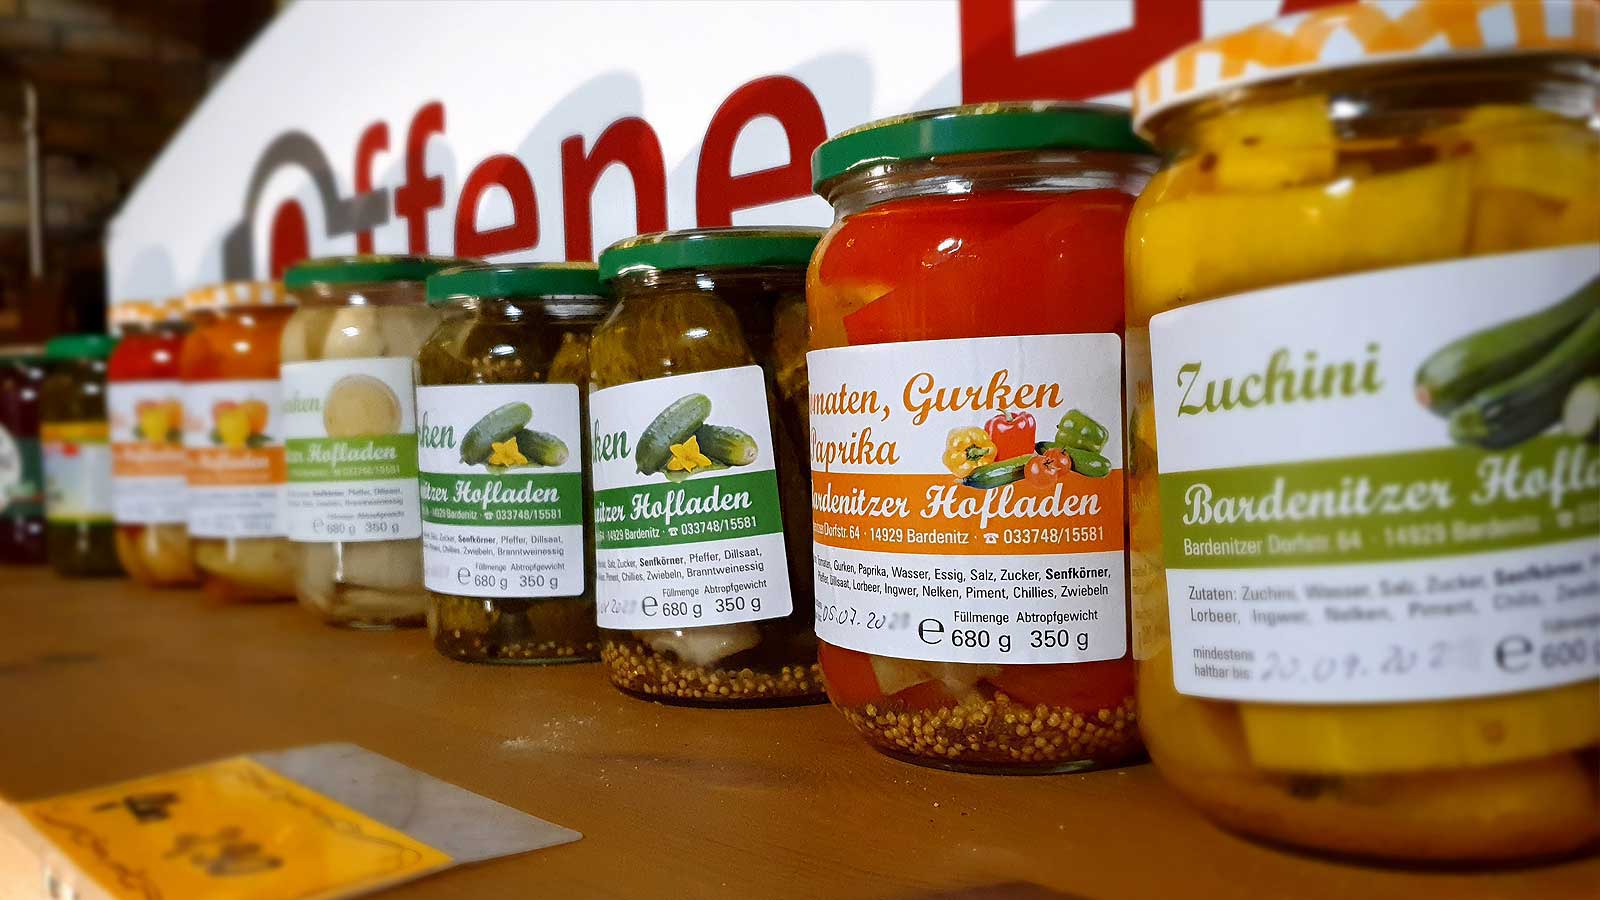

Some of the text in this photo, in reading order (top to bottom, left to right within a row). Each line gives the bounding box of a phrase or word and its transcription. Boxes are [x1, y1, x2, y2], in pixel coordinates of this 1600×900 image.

[1177, 343, 1384, 417] Zuchini
[810, 369, 1063, 426] maten, Gurken
[418, 411, 456, 449] ken
[592, 418, 631, 464] ken
[453, 480, 560, 510] Hofladen
[630, 485, 752, 525] Hofladen
[1183, 476, 1454, 526] Bardenitzer
[496, 509, 561, 519] 033748/15581
[811, 482, 910, 518] ardenitzer
[920, 482, 1101, 530] Hofladen
[625, 526, 661, 540] Bardenitz
[681, 516, 757, 535] 033748/15581
[824, 522, 849, 538] Dorfstr.
[849, 526, 860, 539] 64
[871, 528, 903, 543] 14929
[907, 528, 969, 544] Bardenitz
[1003, 526, 1104, 544] 033748/15581
[498, 547, 564, 557] Branntweinessig
[1184, 536, 1263, 556] Bardenitzer
[511, 562, 565, 573] Abtropfgewicht
[640, 556, 687, 568] Senfkörner,
[689, 552, 721, 564] Pfeffer,
[724, 547, 762, 561] Dillsaat,
[646, 568, 685, 581] Zwiebeln,
[687, 561, 765, 578] Branntweinessig
[833, 559, 857, 575] Gurken,
[858, 562, 889, 579] Paprika,
[892, 566, 931, 581] Wasser,
[934, 568, 967, 583] Essig,
[970, 568, 998, 582] Salz,
[1000, 569, 1042, 582] Zucker,
[1045, 566, 1111, 581] Senfkörner,
[474, 574, 496, 588] 680
[500, 576, 508, 590] g
[519, 575, 545, 588] 350
[549, 577, 558, 590] g
[662, 579, 767, 599] Füllmenge Abtropfgewicht
[853, 581, 882, 595] Lorbeer,
[884, 582, 919, 598] Ingwer,
[922, 585, 962, 600] Nelken,
[966, 586, 1010, 600] Piment,
[1013, 586, 1058, 599] Chillies,
[1061, 584, 1109, 598] Zwiebeln
[1188, 585, 1238, 601] Zutaten:
[662, 601, 688, 617] 680
[692, 603, 702, 618] g
[715, 596, 745, 613] 350
[751, 598, 761, 612] g
[954, 609, 1099, 625] Füllmenge Abtropfgewicht
[1190, 607, 1241, 625] Lorbeer,
[951, 629, 990, 648] 680
[998, 634, 1011, 652] g
[1030, 629, 1069, 648] 350
[1076, 632, 1089, 651] g
[1193, 646, 1256, 662] mindestens
[1194, 663, 1229, 678] haltbar
